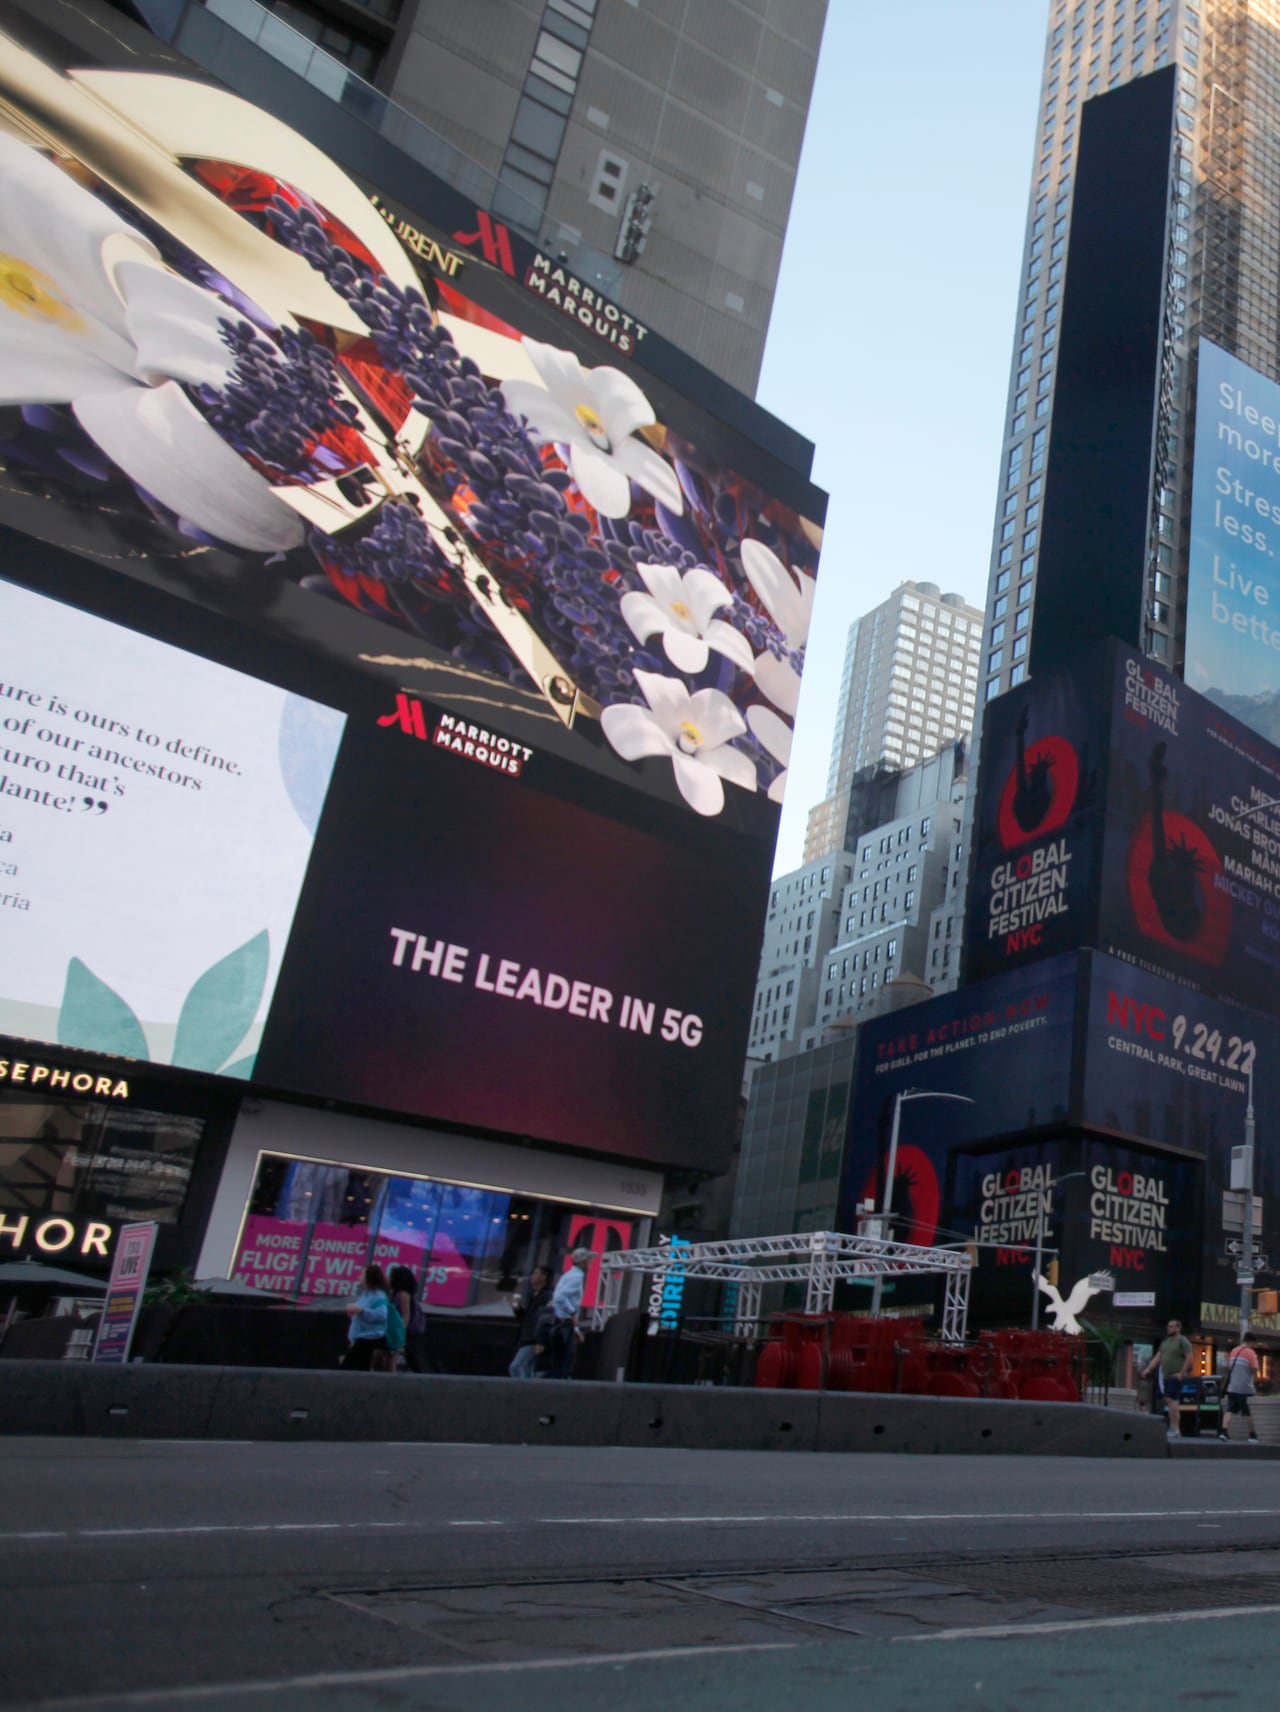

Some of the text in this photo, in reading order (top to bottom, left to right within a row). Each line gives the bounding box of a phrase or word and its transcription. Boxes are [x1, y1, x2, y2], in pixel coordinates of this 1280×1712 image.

[528, 271, 631, 351] MARQUIS
[534, 253, 649, 341] MARRIOTT
[1215, 499, 1276, 557] less.
[1212, 554, 1270, 606] Live
[1125, 658, 1181, 707] GLOBAL
[1125, 674, 1178, 722] CITIZEN
[47, 695, 69, 716] is
[74, 709, 130, 737] ours
[136, 728, 160, 747] to
[165, 739, 242, 776] define.
[1124, 691, 1179, 737] FESTIVAL
[3, 717, 203, 791] of our ancestors
[436, 729, 521, 775] MARQUIS
[440, 713, 533, 763] MARRIOTT
[56, 763, 126, 797] that's
[1208, 804, 1252, 840] JONAS
[990, 838, 1072, 890] GLOBAL
[1224, 855, 1273, 893] MARIAH
[989, 864, 1069, 916] CITIZEN
[1214, 872, 1263, 912] MICKEY
[988, 891, 1068, 939] FESTIVAL
[1007, 923, 1043, 955] NYC
[1116, 949, 1136, 965] FREE
[390, 927, 704, 1048] THE LEADER IN 5G
[877, 992, 1051, 1059] TAKE ACTION NOW
[1107, 989, 1167, 1041] NYC
[1171, 1014, 1257, 1075] 9.24.22
[875, 1061, 889, 1075] FOR
[890, 1056, 913, 1071] GIRLS.
[913, 1050, 930, 1063] FOR
[930, 1046, 945, 1058] THE
[945, 1037, 977, 1054] PLANET.
[977, 1033, 990, 1043] TO
[989, 1027, 1007, 1041] END
[1107, 1036, 1246, 1094] CENTRAL PARK, GREAT LAWN
[0, 1059, 129, 1098] SEPHORA
[981, 1163, 1057, 1198] GLOBAL
[1091, 1164, 1170, 1205] GLOBAL
[979, 1216, 1054, 1245] FESTIVAL
[980, 1190, 1053, 1225] CITIZEN
[1090, 1191, 1167, 1230] CITIZEN
[255, 1233, 300, 1251] MORE
[996, 1243, 1030, 1267] NYC
[1090, 1217, 1168, 1252] FESTIVAL
[1109, 1245, 1146, 1271] NYC
